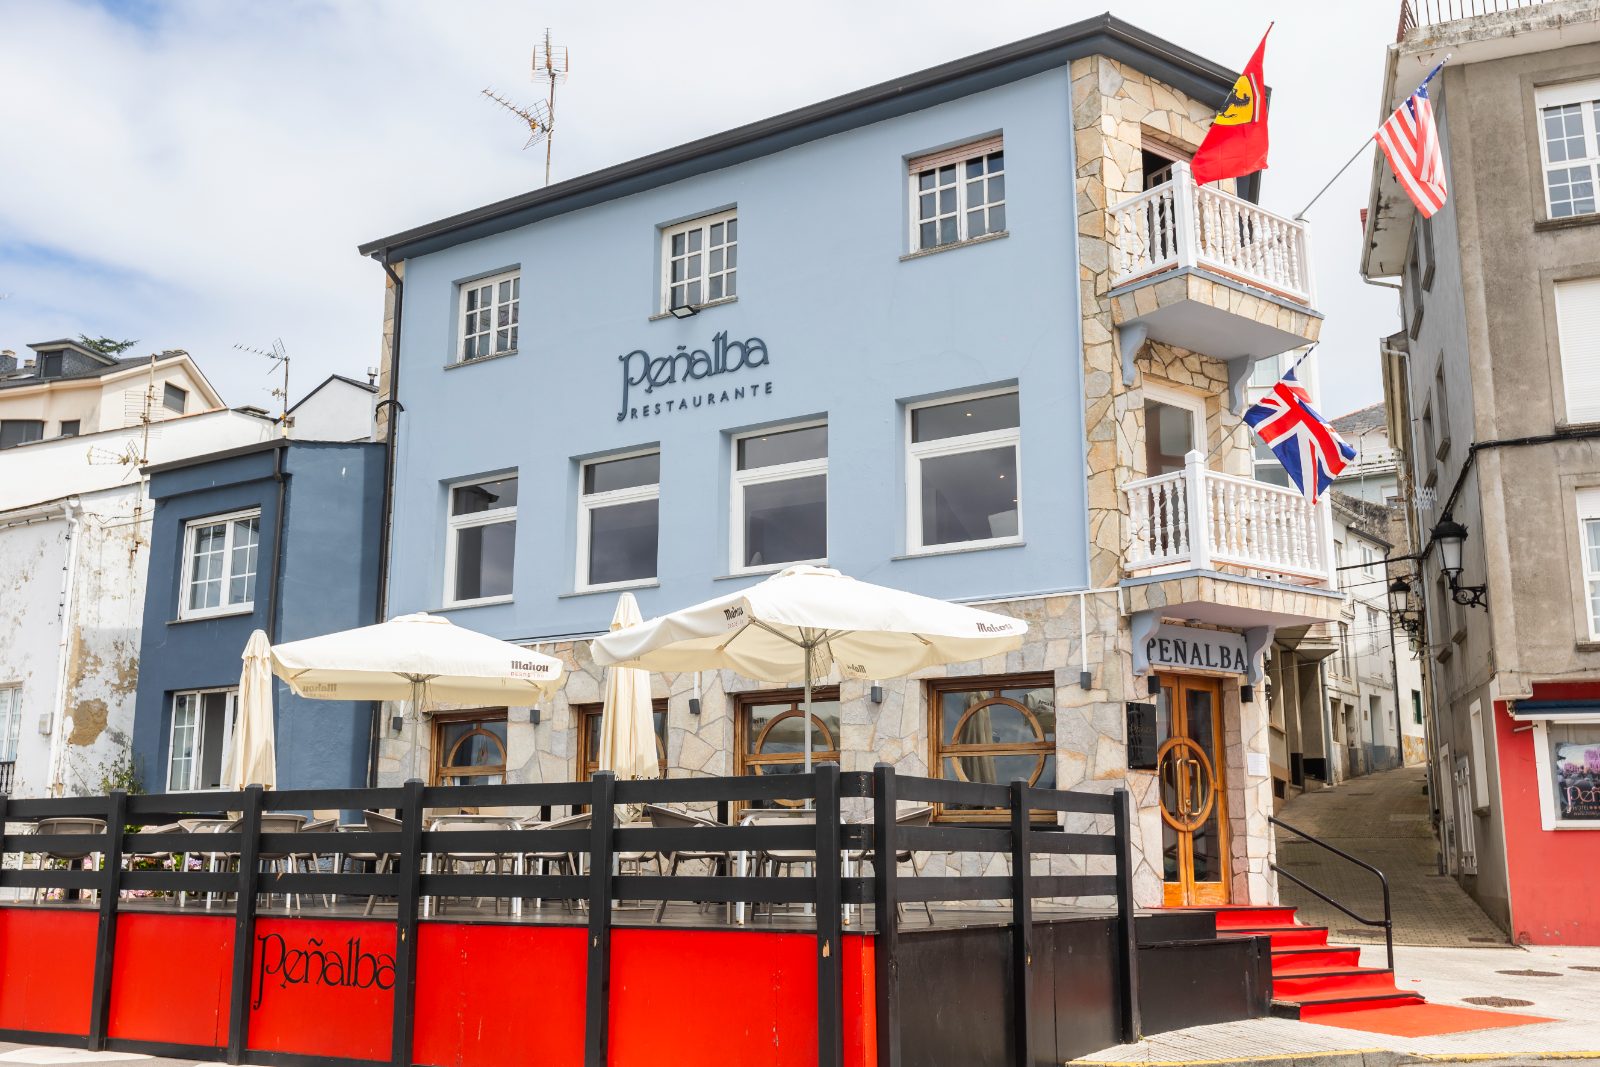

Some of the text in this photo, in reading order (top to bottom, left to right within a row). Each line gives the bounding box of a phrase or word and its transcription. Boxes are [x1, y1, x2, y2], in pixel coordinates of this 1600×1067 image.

[630, 382, 773, 419] RESTAURANTE
[511, 660, 549, 672] Mahou
[1146, 637, 1249, 671] PEÑALBA
